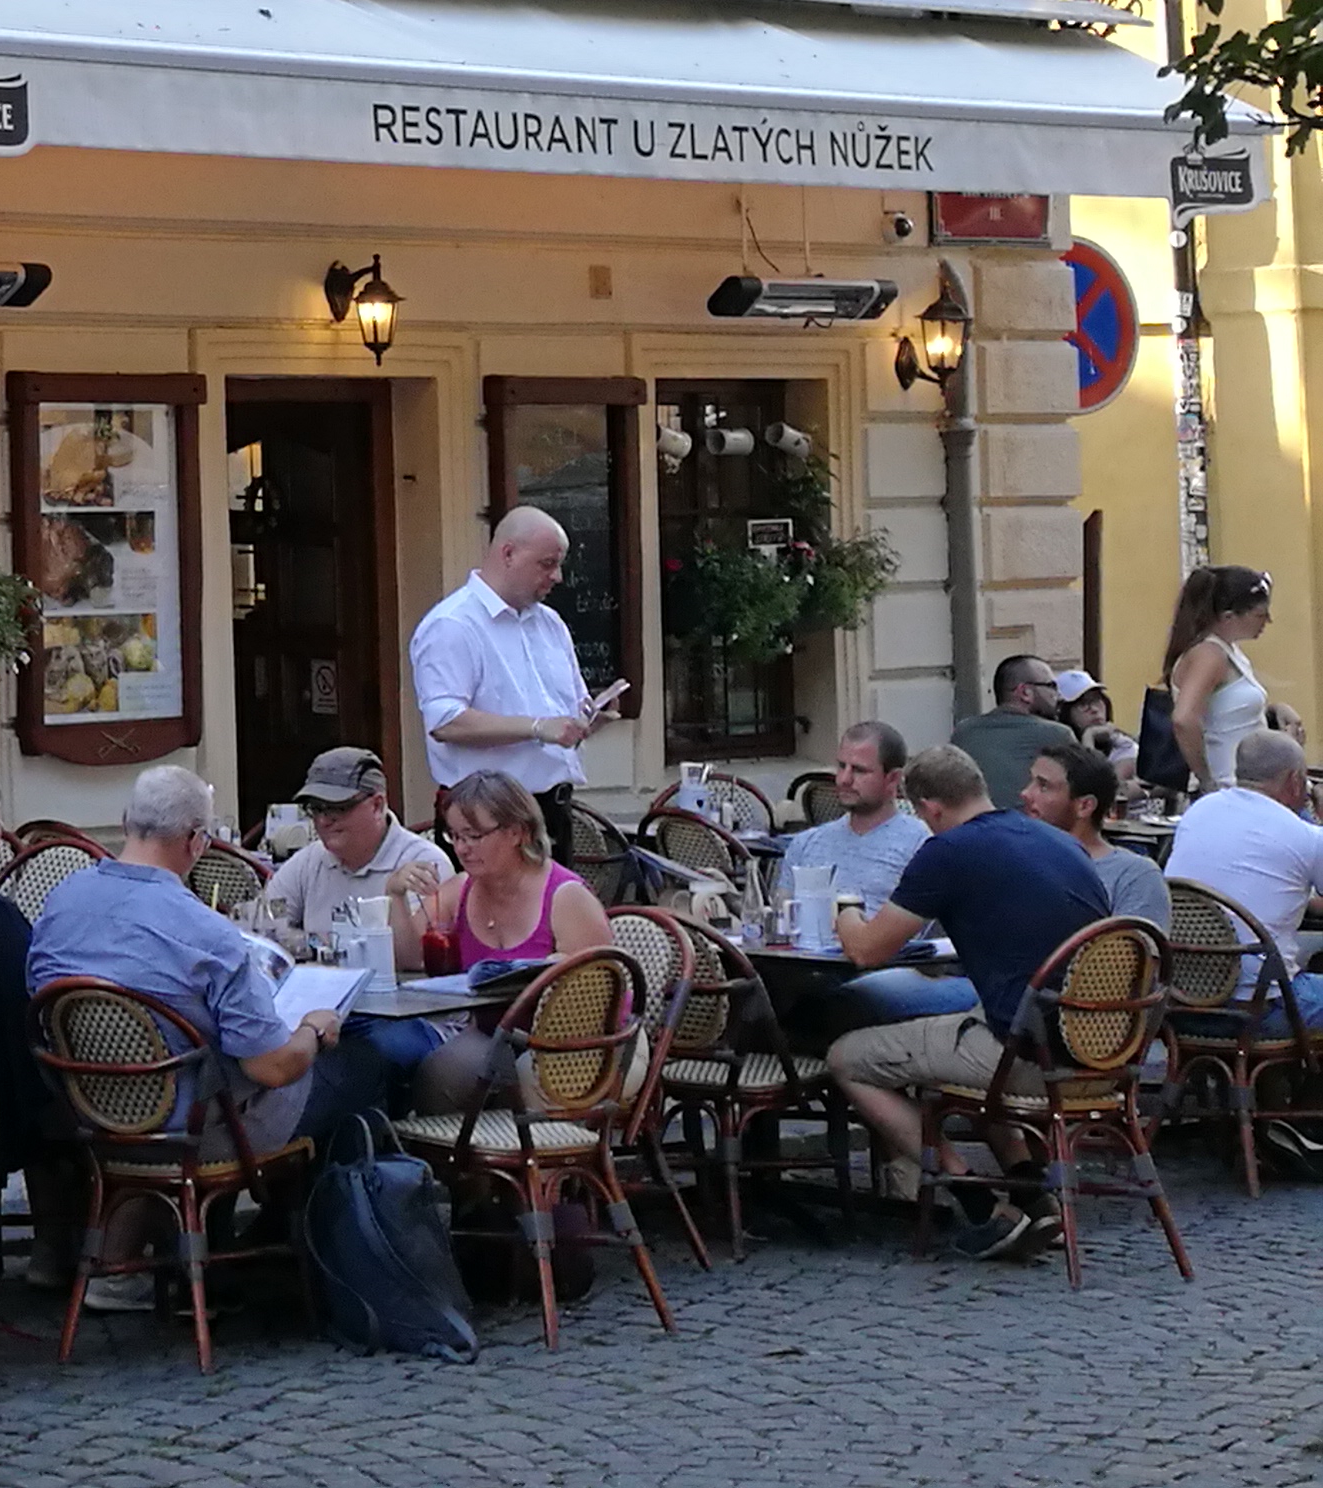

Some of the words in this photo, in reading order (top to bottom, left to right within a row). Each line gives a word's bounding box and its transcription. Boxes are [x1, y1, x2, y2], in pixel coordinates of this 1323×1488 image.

[371, 103, 619, 156] RESTAURANT
[632, 119, 656, 158] U
[667, 117, 817, 166] ZLATÝCH
[829, 120, 935, 173] NŮŽEK
